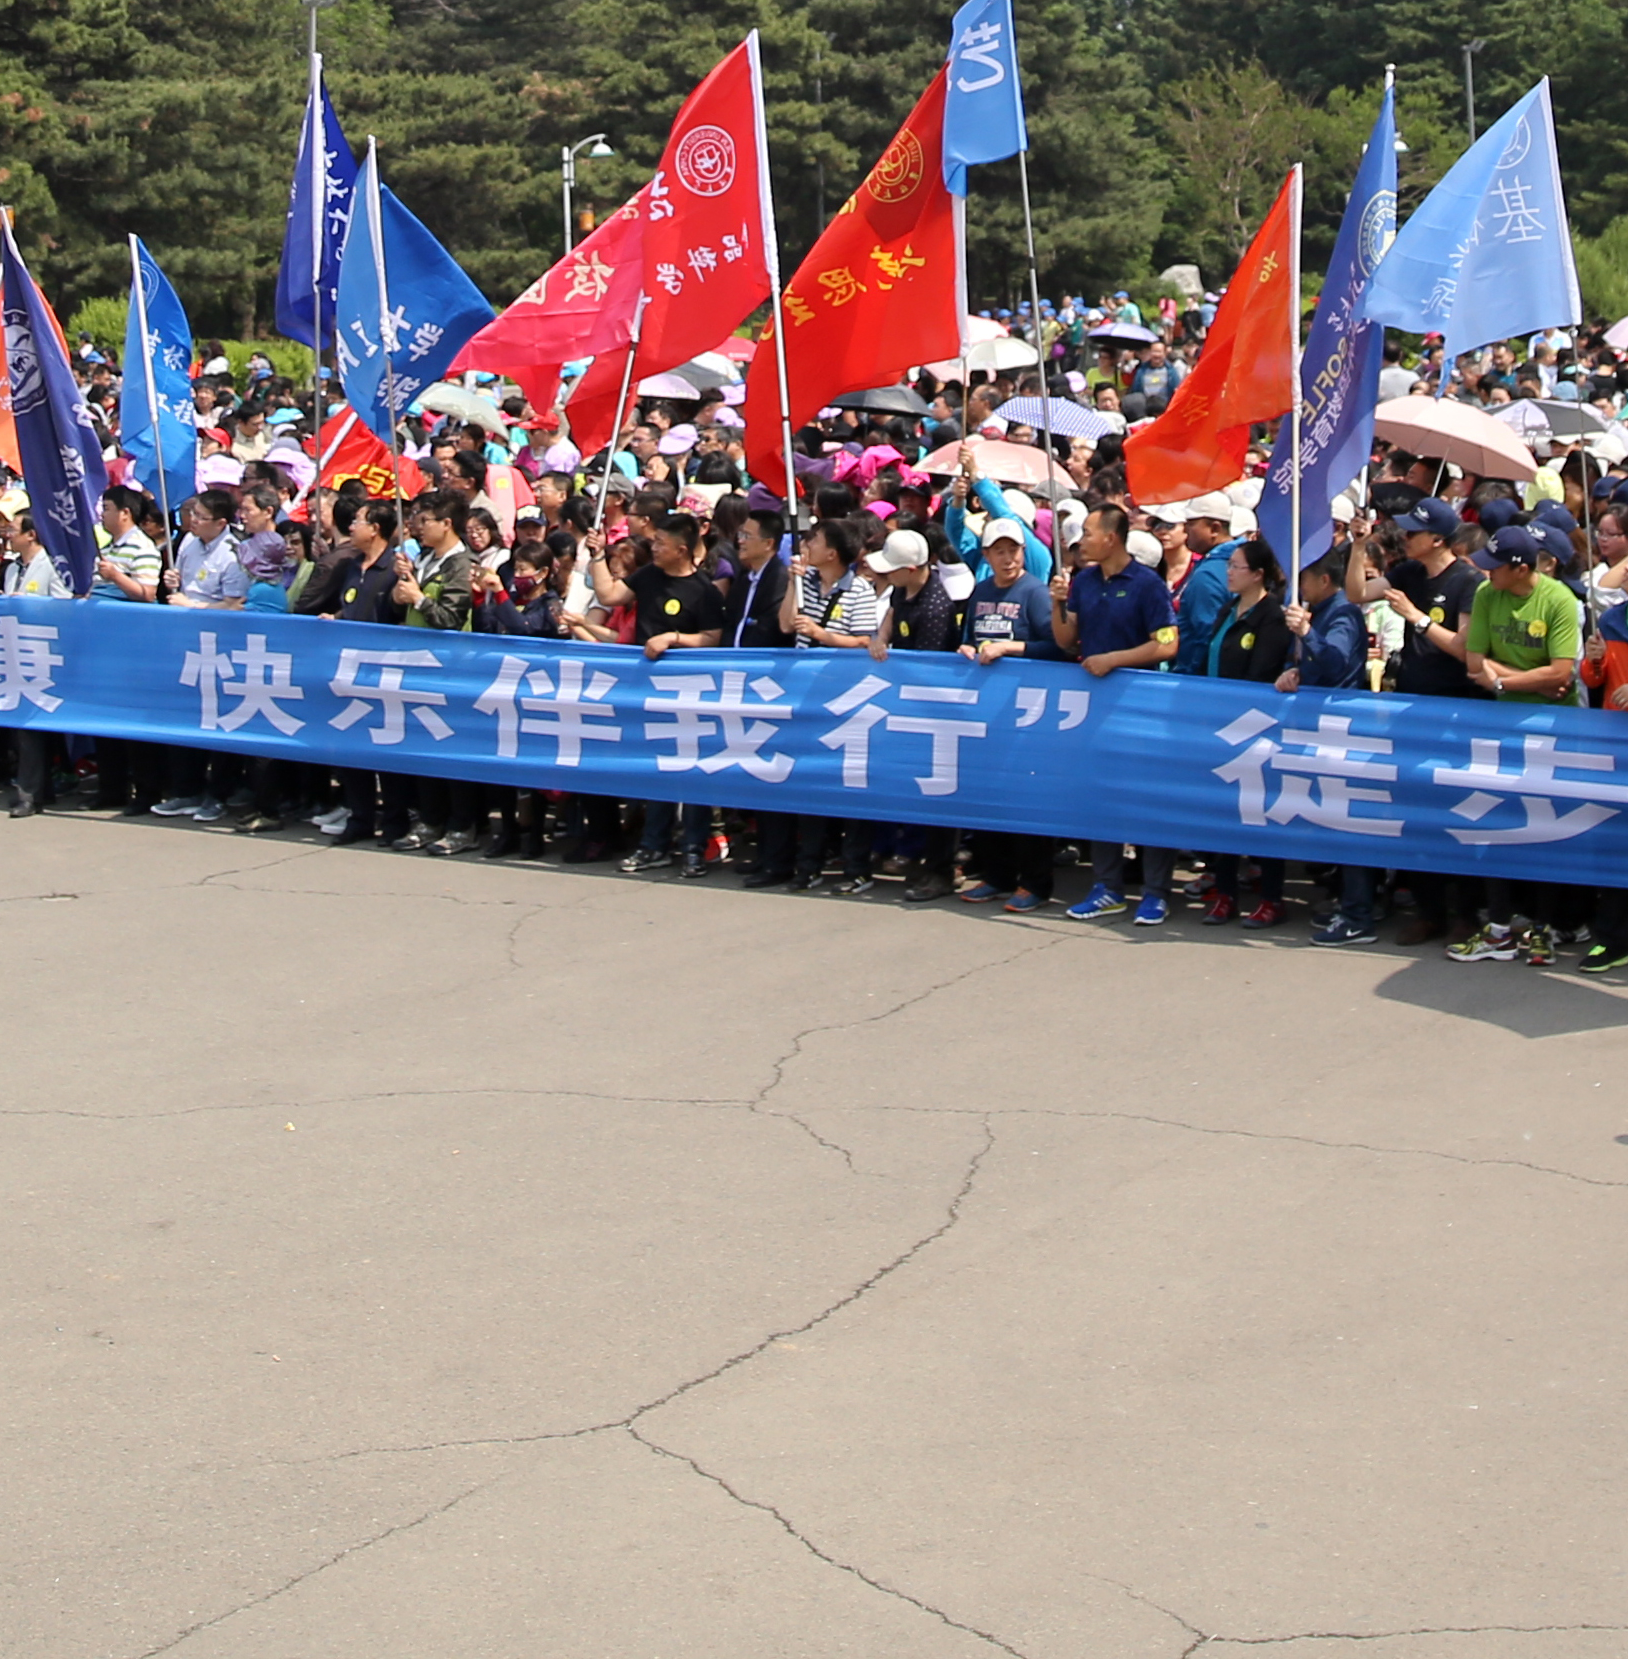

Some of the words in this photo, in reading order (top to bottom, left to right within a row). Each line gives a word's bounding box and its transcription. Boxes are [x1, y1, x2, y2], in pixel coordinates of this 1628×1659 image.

[178, 632, 1091, 797] 快乐伴我行”
